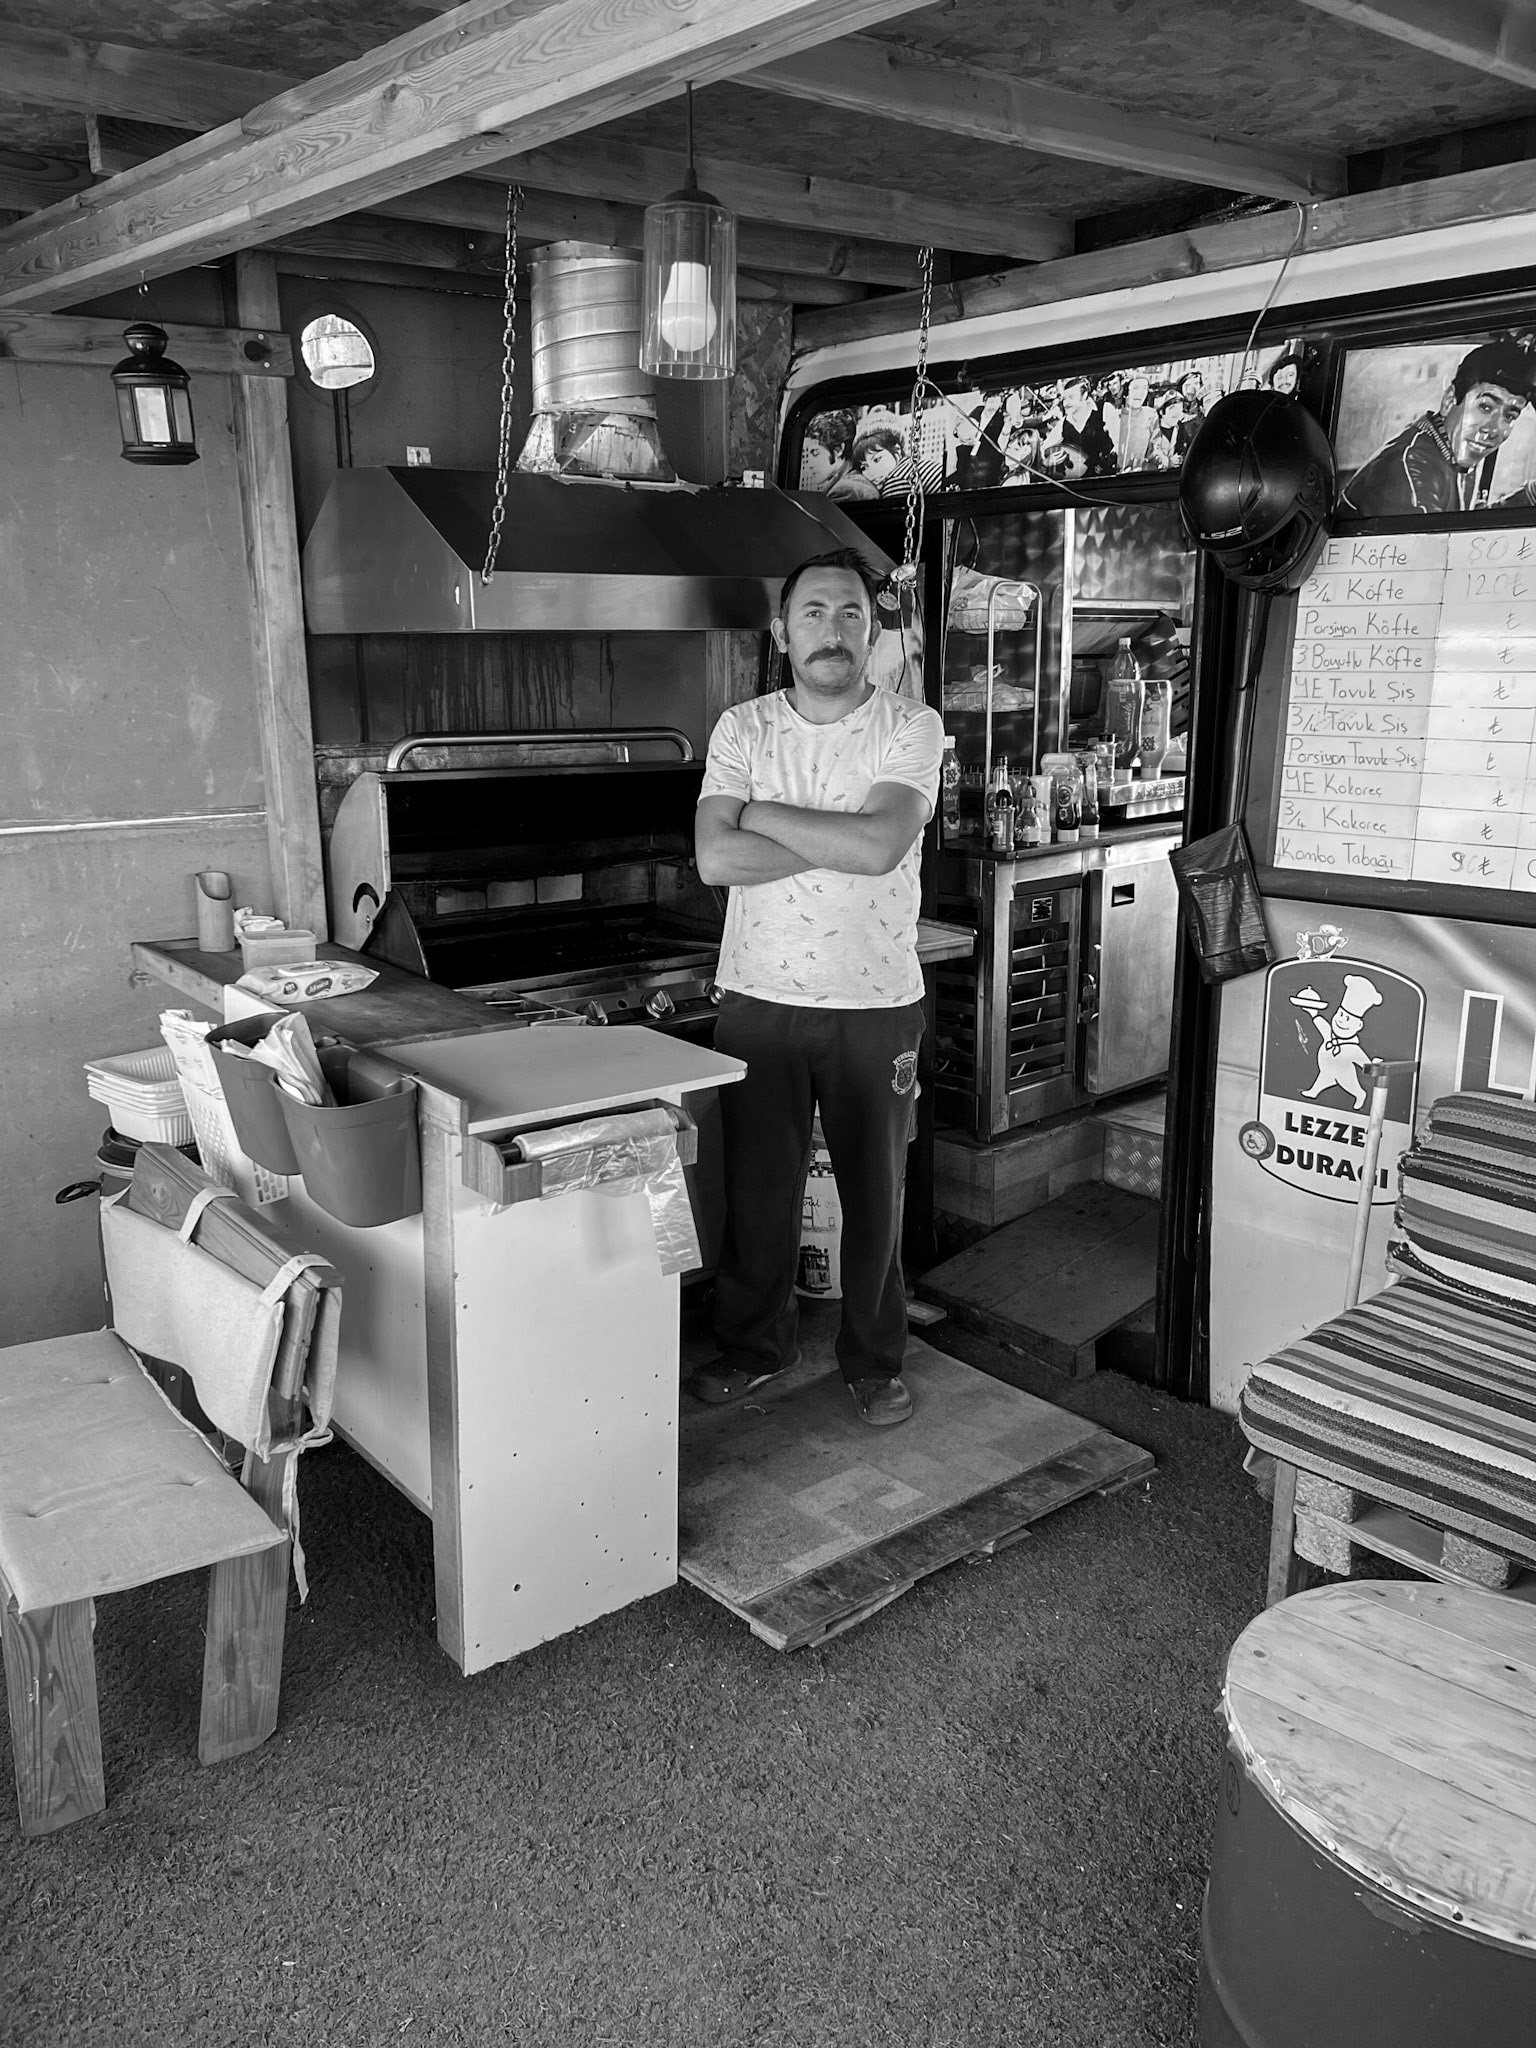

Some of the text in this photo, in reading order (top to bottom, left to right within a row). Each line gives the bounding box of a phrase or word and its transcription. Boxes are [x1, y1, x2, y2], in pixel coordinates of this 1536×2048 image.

[1200, 526, 1242, 539] LS2
[1351, 543, 1408, 568] Köfte
[1308, 577, 1405, 603] 3/4 Köfte
[1304, 610, 1419, 637] Porsiyon Köfte
[1297, 643, 1423, 670] 3 Boyutlu Köfte
[1329, 678, 1377, 699] Tavuk
[1387, 681, 1415, 703] Şiş
[1291, 705, 1408, 734] 3/4 Tavuk Şiş
[1288, 737, 1346, 766] Porsiyon
[1347, 741, 1388, 766] Tavuk
[1324, 773, 1382, 798] Kokoreç
[1284, 801, 1386, 834] 3/4 Kokoreç
[1280, 836, 1394, 873] Kombo Tabağı
[1285, 1111, 1382, 1148] LEZZE
